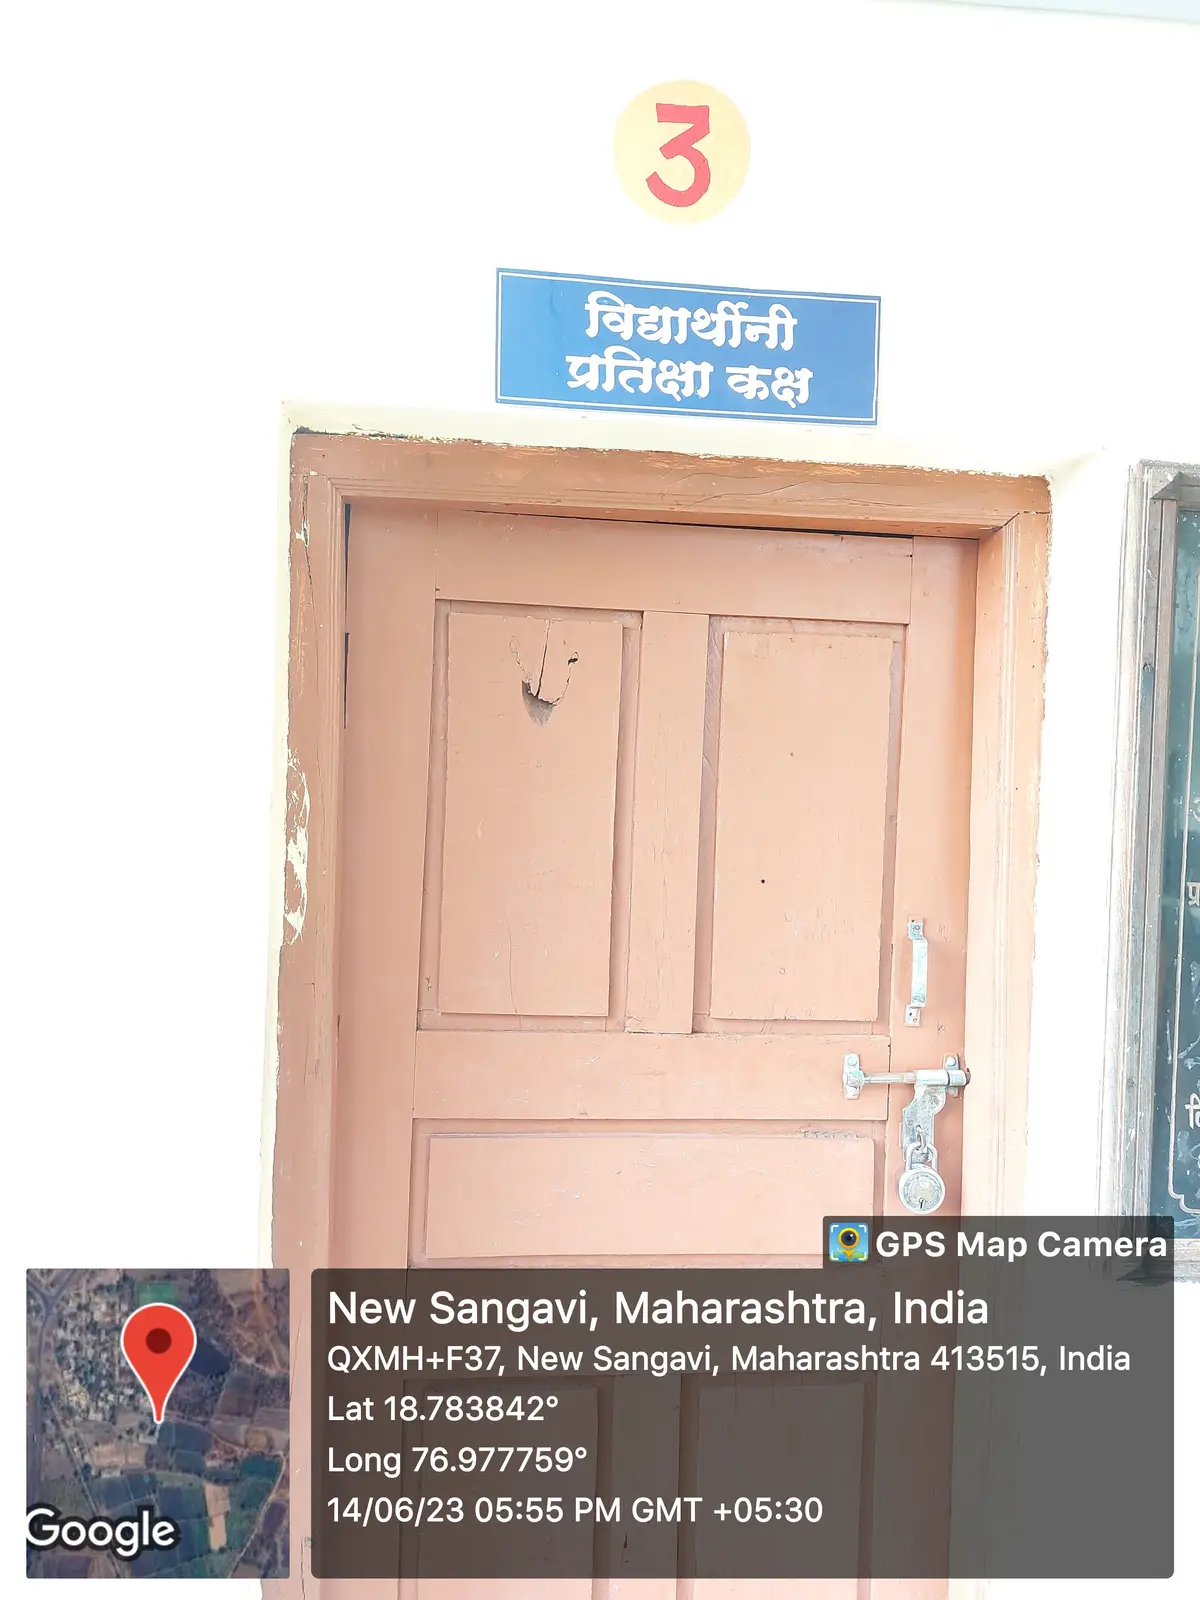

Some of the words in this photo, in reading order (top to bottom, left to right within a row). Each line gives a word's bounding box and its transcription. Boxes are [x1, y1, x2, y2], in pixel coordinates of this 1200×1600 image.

[645, 103, 712, 208] 3
[584, 290, 798, 351] विद्यार्थीनी
[565, 345, 714, 402] प्रतिक्षा
[725, 364, 814, 409] कक्ष
